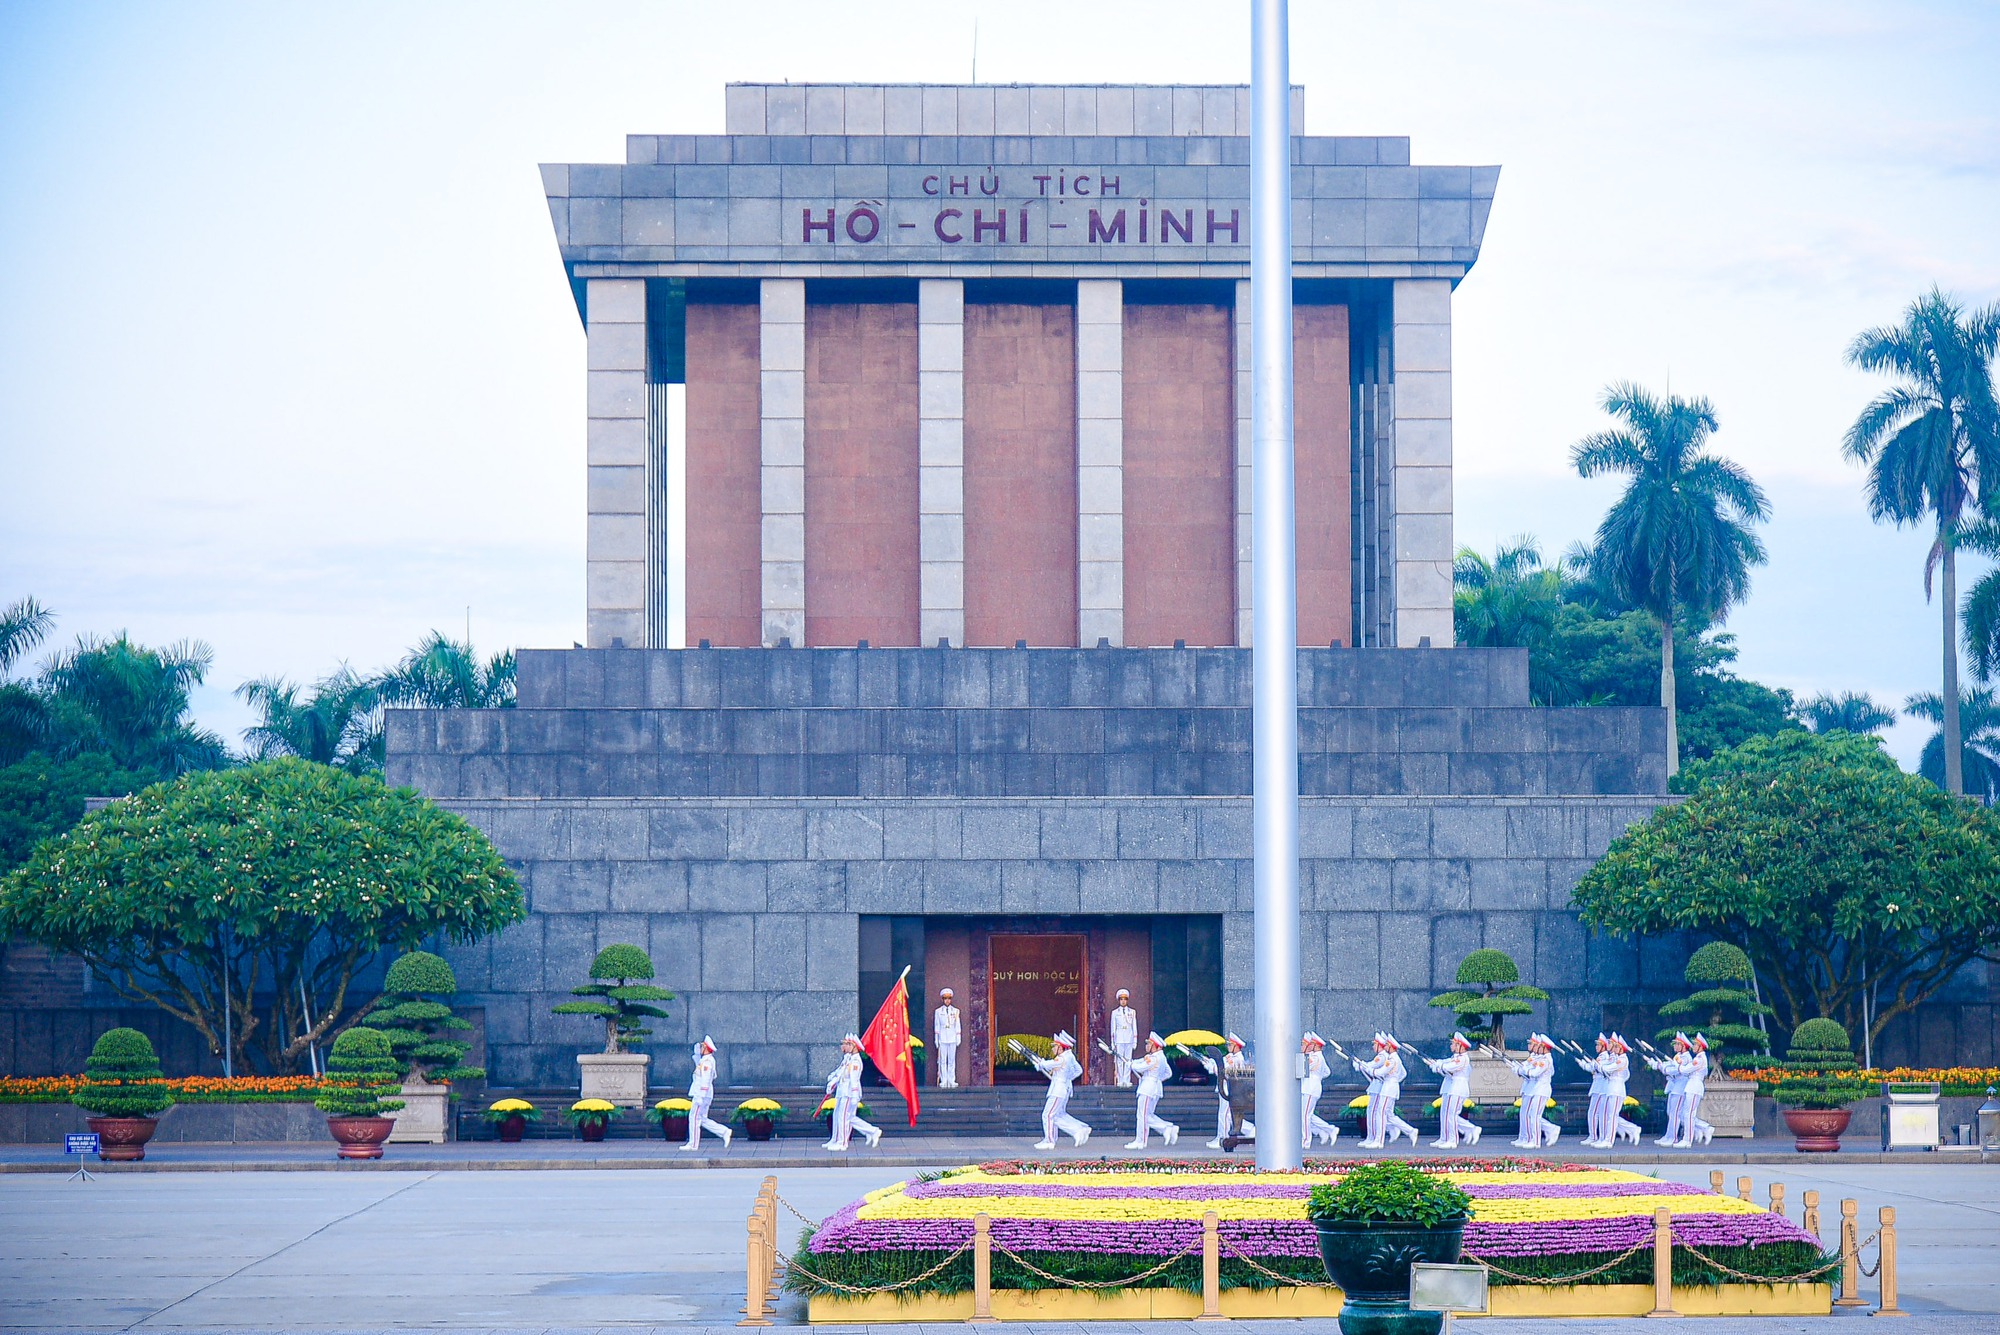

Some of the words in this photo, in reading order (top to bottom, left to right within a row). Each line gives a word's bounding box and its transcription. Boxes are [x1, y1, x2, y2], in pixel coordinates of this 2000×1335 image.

[922, 166, 999, 195] CHỦ
[1032, 168, 1120, 204] TỊCH
[803, 200, 883, 243] HỒ
[934, 199, 1034, 243] CHÍ
[1088, 198, 1239, 243] MINH
[1017, 971, 1039, 980] HƠN
